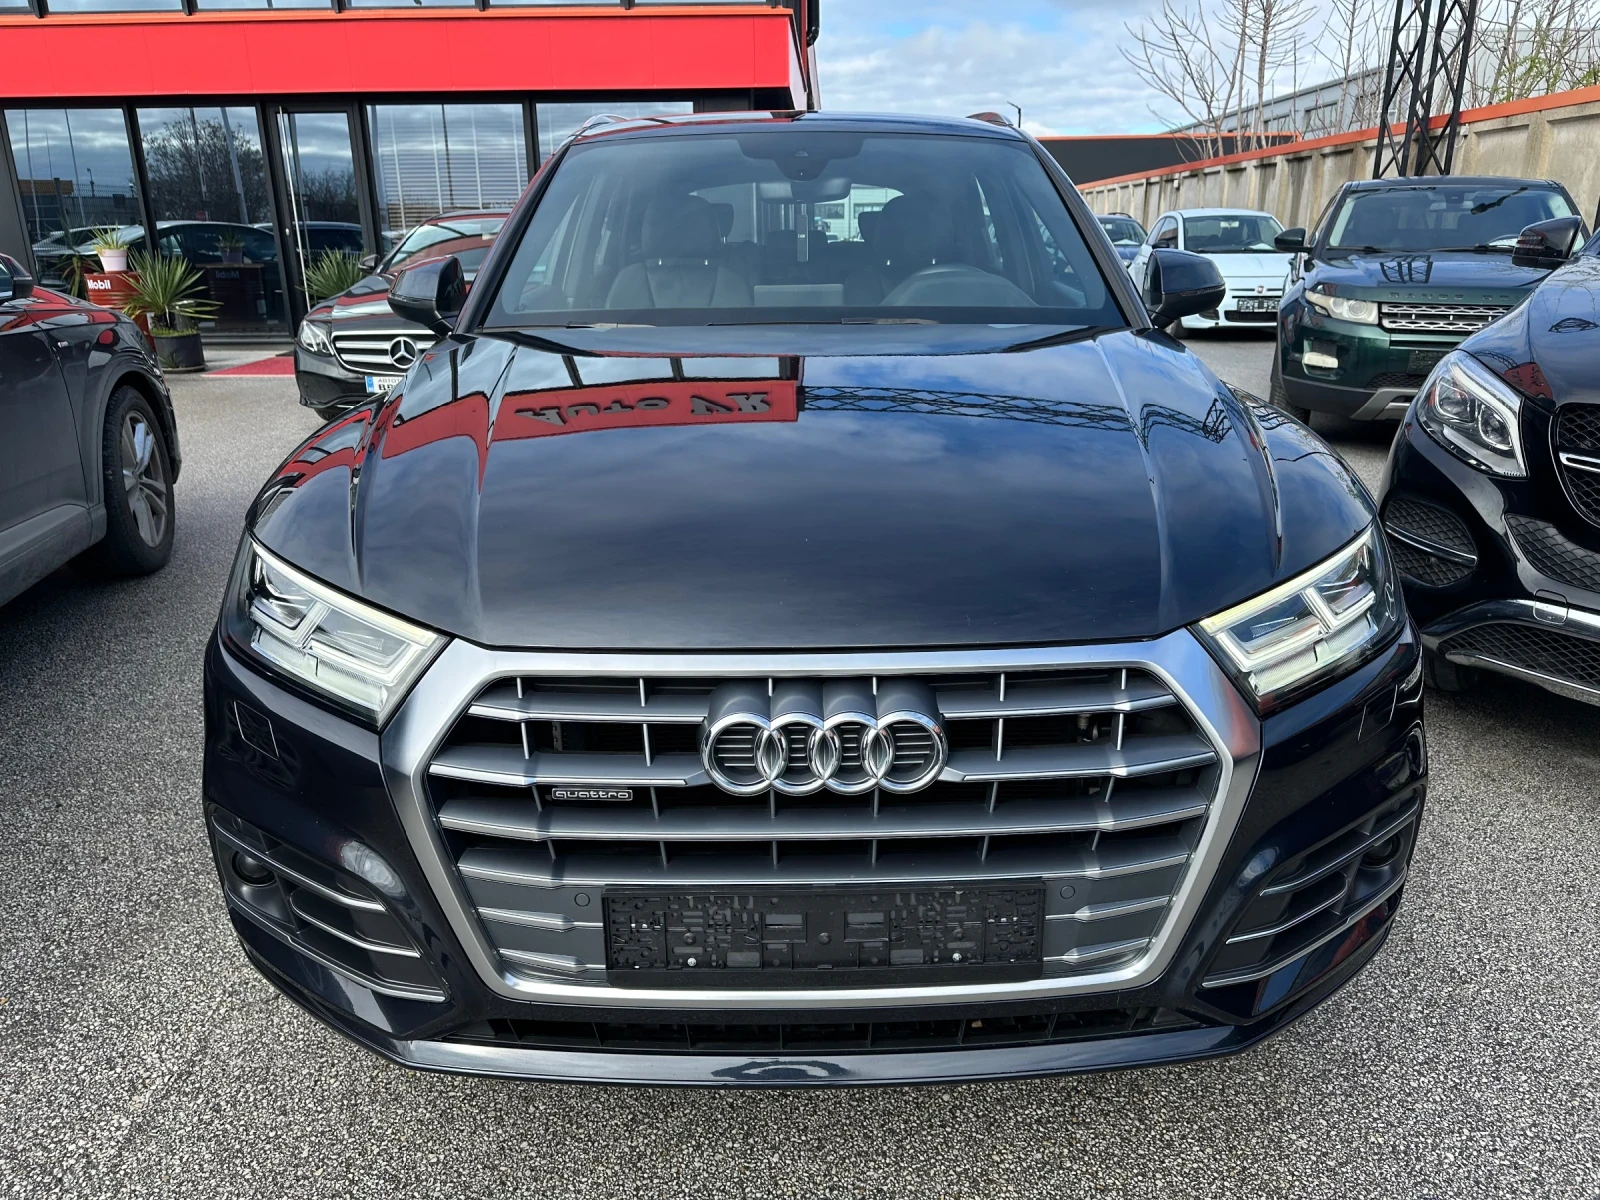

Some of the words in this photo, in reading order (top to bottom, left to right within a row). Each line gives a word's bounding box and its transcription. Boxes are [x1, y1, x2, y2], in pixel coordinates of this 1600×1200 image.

[87, 280, 111, 289] Mobil
[1389, 291, 1464, 300] RANGE
[555, 790, 629, 799] quattro
